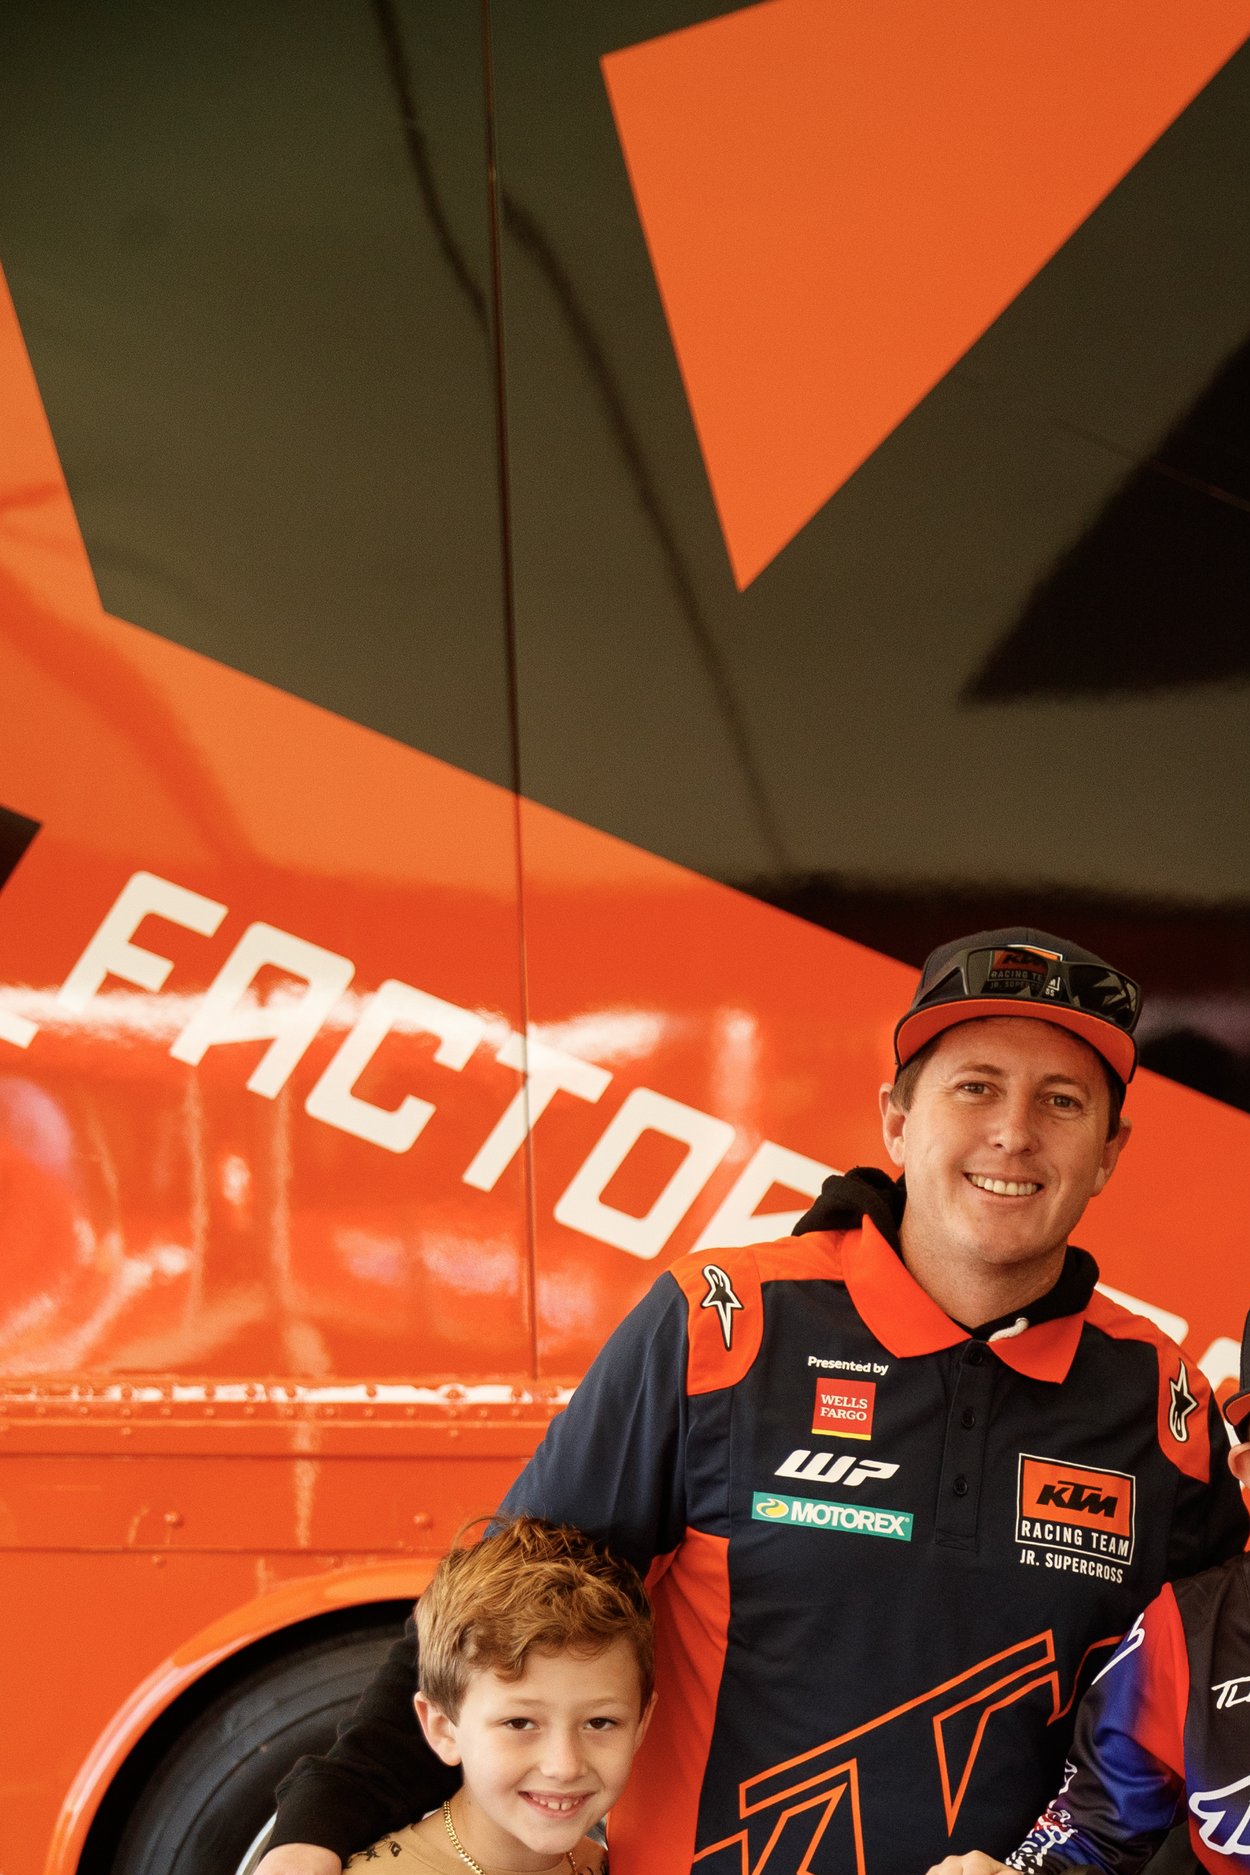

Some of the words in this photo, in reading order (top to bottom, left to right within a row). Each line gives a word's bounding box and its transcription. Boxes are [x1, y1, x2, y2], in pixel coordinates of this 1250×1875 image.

[807, 1356, 871, 1373] Presented
[873, 1362, 889, 1375] by
[819, 1407, 867, 1421] FARGO
[820, 1394, 868, 1409] WELLS
[774, 1449, 900, 1487] WP
[1035, 1480, 1119, 1519] KTM
[790, 1500, 906, 1537] MOTOREX
[1021, 1519, 1083, 1546] RACING
[1090, 1531, 1130, 1558] TEAM
[1020, 1548, 1040, 1567] JR.
[1044, 1552, 1124, 1584] SUPERCROSS
